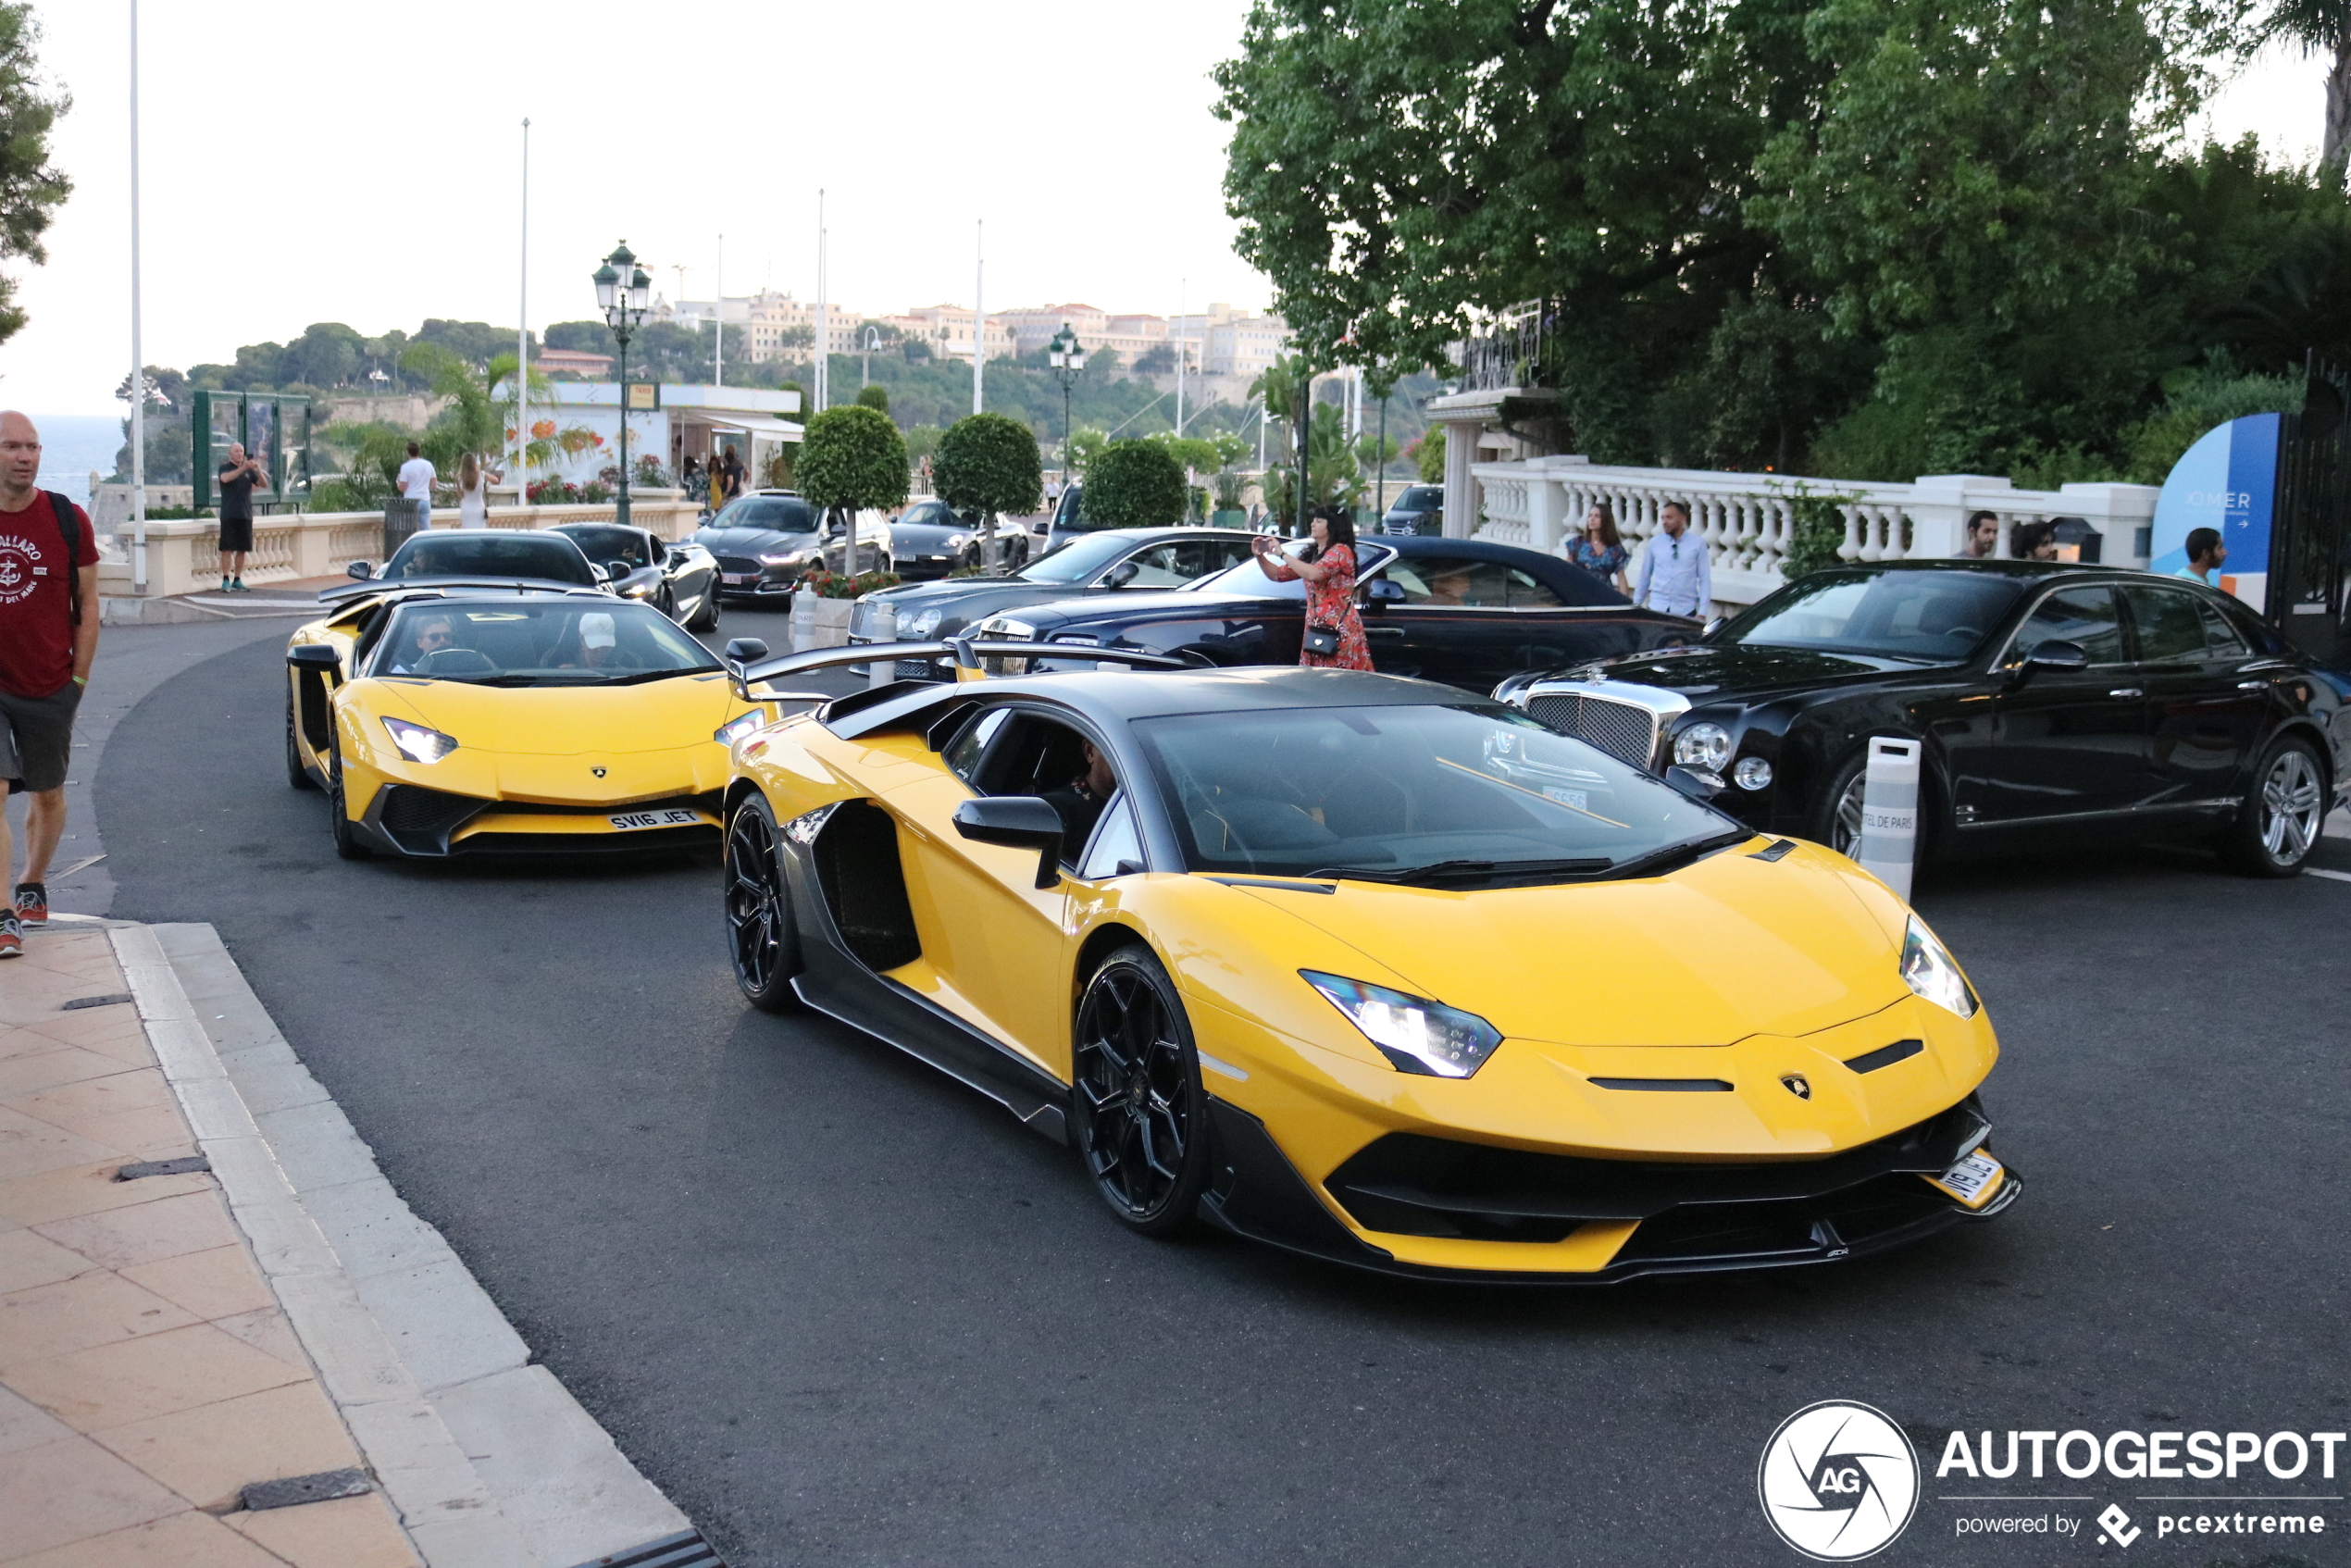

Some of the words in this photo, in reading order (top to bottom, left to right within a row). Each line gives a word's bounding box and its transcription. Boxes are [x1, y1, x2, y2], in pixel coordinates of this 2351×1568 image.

[6, 594, 20, 604] DEL
[20, 579, 38, 599] MARE
[611, 814, 658, 829] SV16
[664, 810, 698, 824] JET
[1877, 815, 1889, 828] DE
[1891, 816, 1912, 829] PARIS
